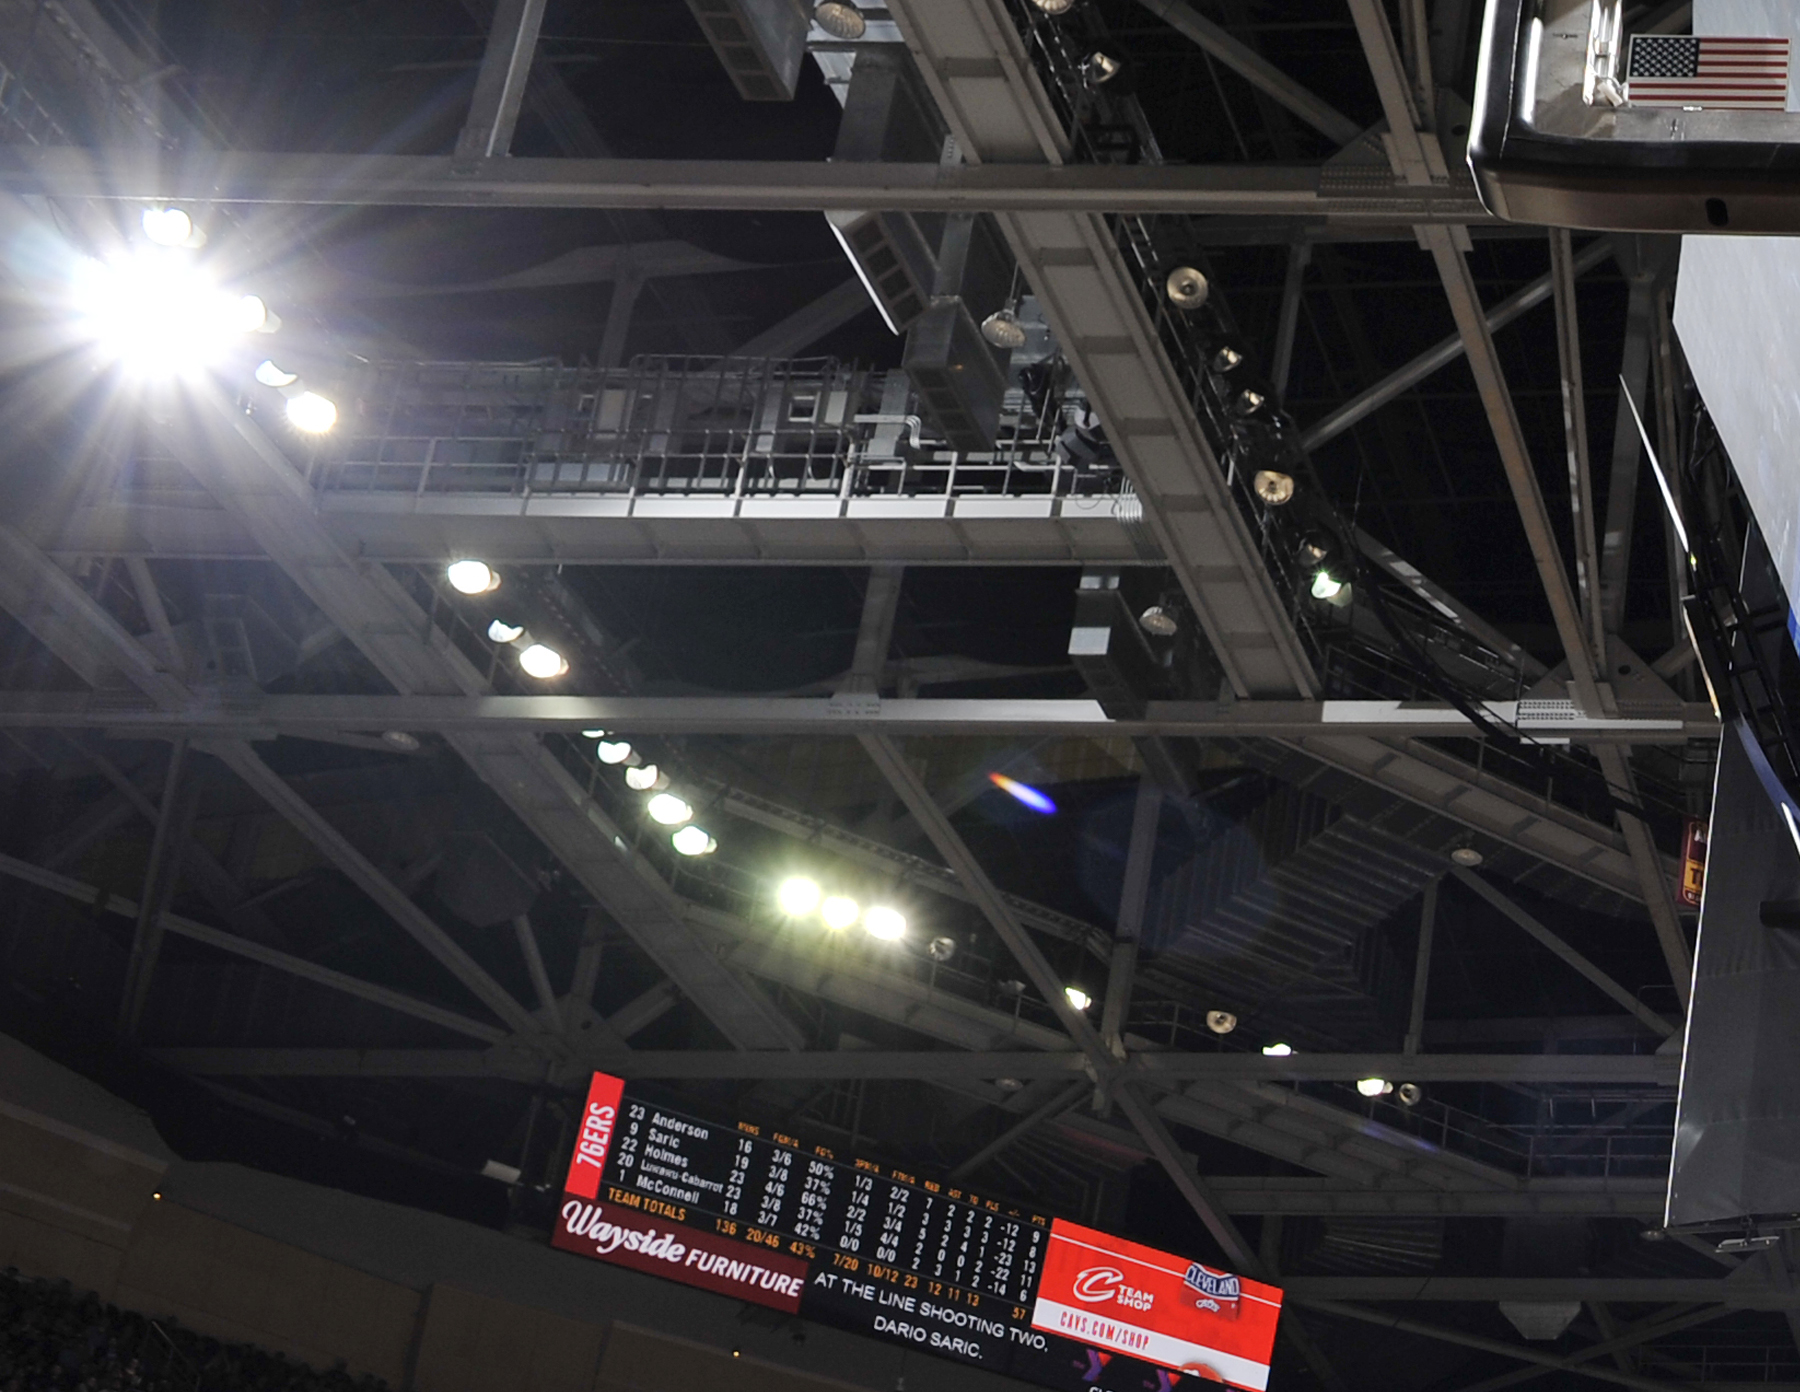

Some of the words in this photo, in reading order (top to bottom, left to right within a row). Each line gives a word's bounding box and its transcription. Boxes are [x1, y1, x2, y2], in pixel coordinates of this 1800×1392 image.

[576, 1102, 615, 1168] 76ERS
[629, 1104, 645, 1120] 23
[651, 1112, 709, 1140] Anderson
[629, 1122, 639, 1135] 9
[648, 1128, 680, 1148] Saric
[617, 1152, 634, 1168] 20
[621, 1137, 638, 1152] 22
[644, 1144, 689, 1168] Holmes
[608, 1187, 641, 1208] TEAM
[643, 1198, 686, 1221] TOTALS
[636, 1174, 700, 1204] McConnell
[561, 1200, 686, 1264] Wayside
[684, 1249, 805, 1298] FURNITURE
[1117, 1284, 1154, 1304] TEAM
[1187, 1264, 1239, 1297] CLEVELAND
[814, 1271, 838, 1289] AT
[841, 1278, 876, 1301] THE
[878, 1289, 916, 1313] LINE
[919, 1301, 1005, 1338] SHOOTING
[1009, 1327, 1049, 1352] TWO.
[1117, 1296, 1152, 1312] SHOP
[873, 1315, 927, 1342] DARIO
[930, 1331, 984, 1360] SARIC.
[1060, 1311, 1150, 1350] CAVS.COM/SHOP
